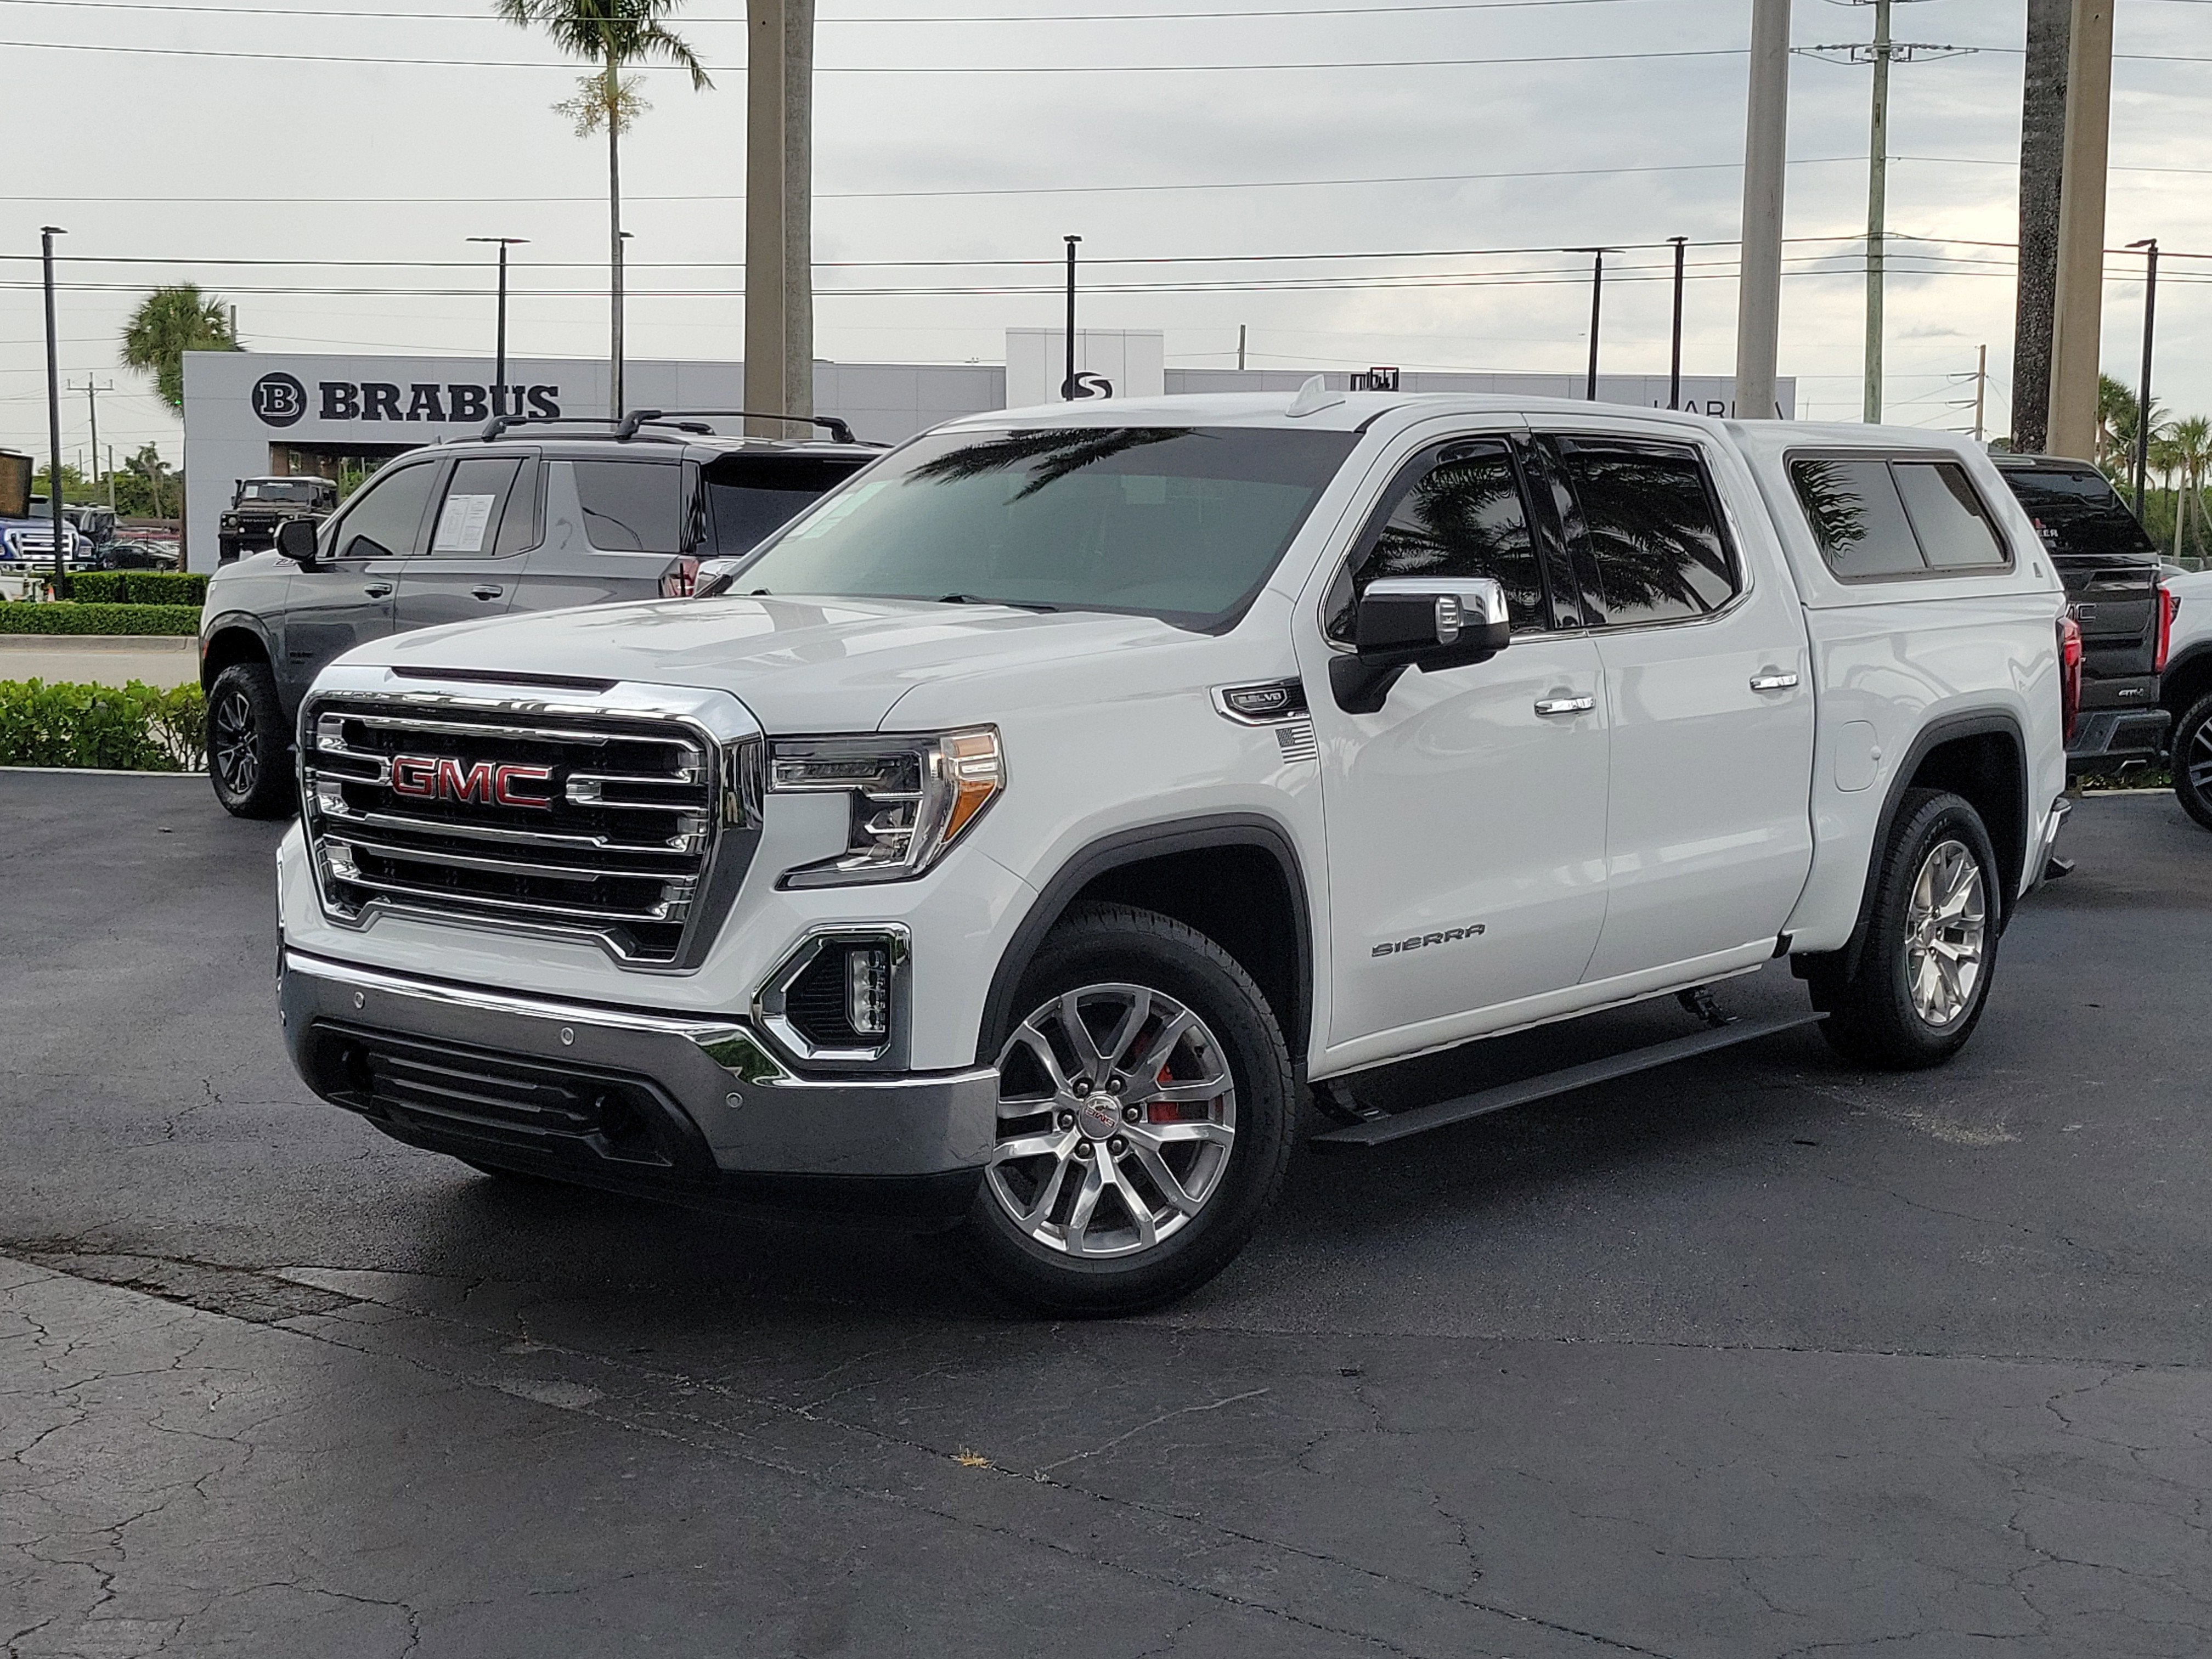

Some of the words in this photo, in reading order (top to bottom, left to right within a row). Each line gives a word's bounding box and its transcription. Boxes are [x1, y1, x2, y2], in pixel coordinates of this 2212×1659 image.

[319, 382, 561, 422] BRABUS
[392, 755, 553, 811] GMC
[1372, 924, 1486, 957] SIERRA
